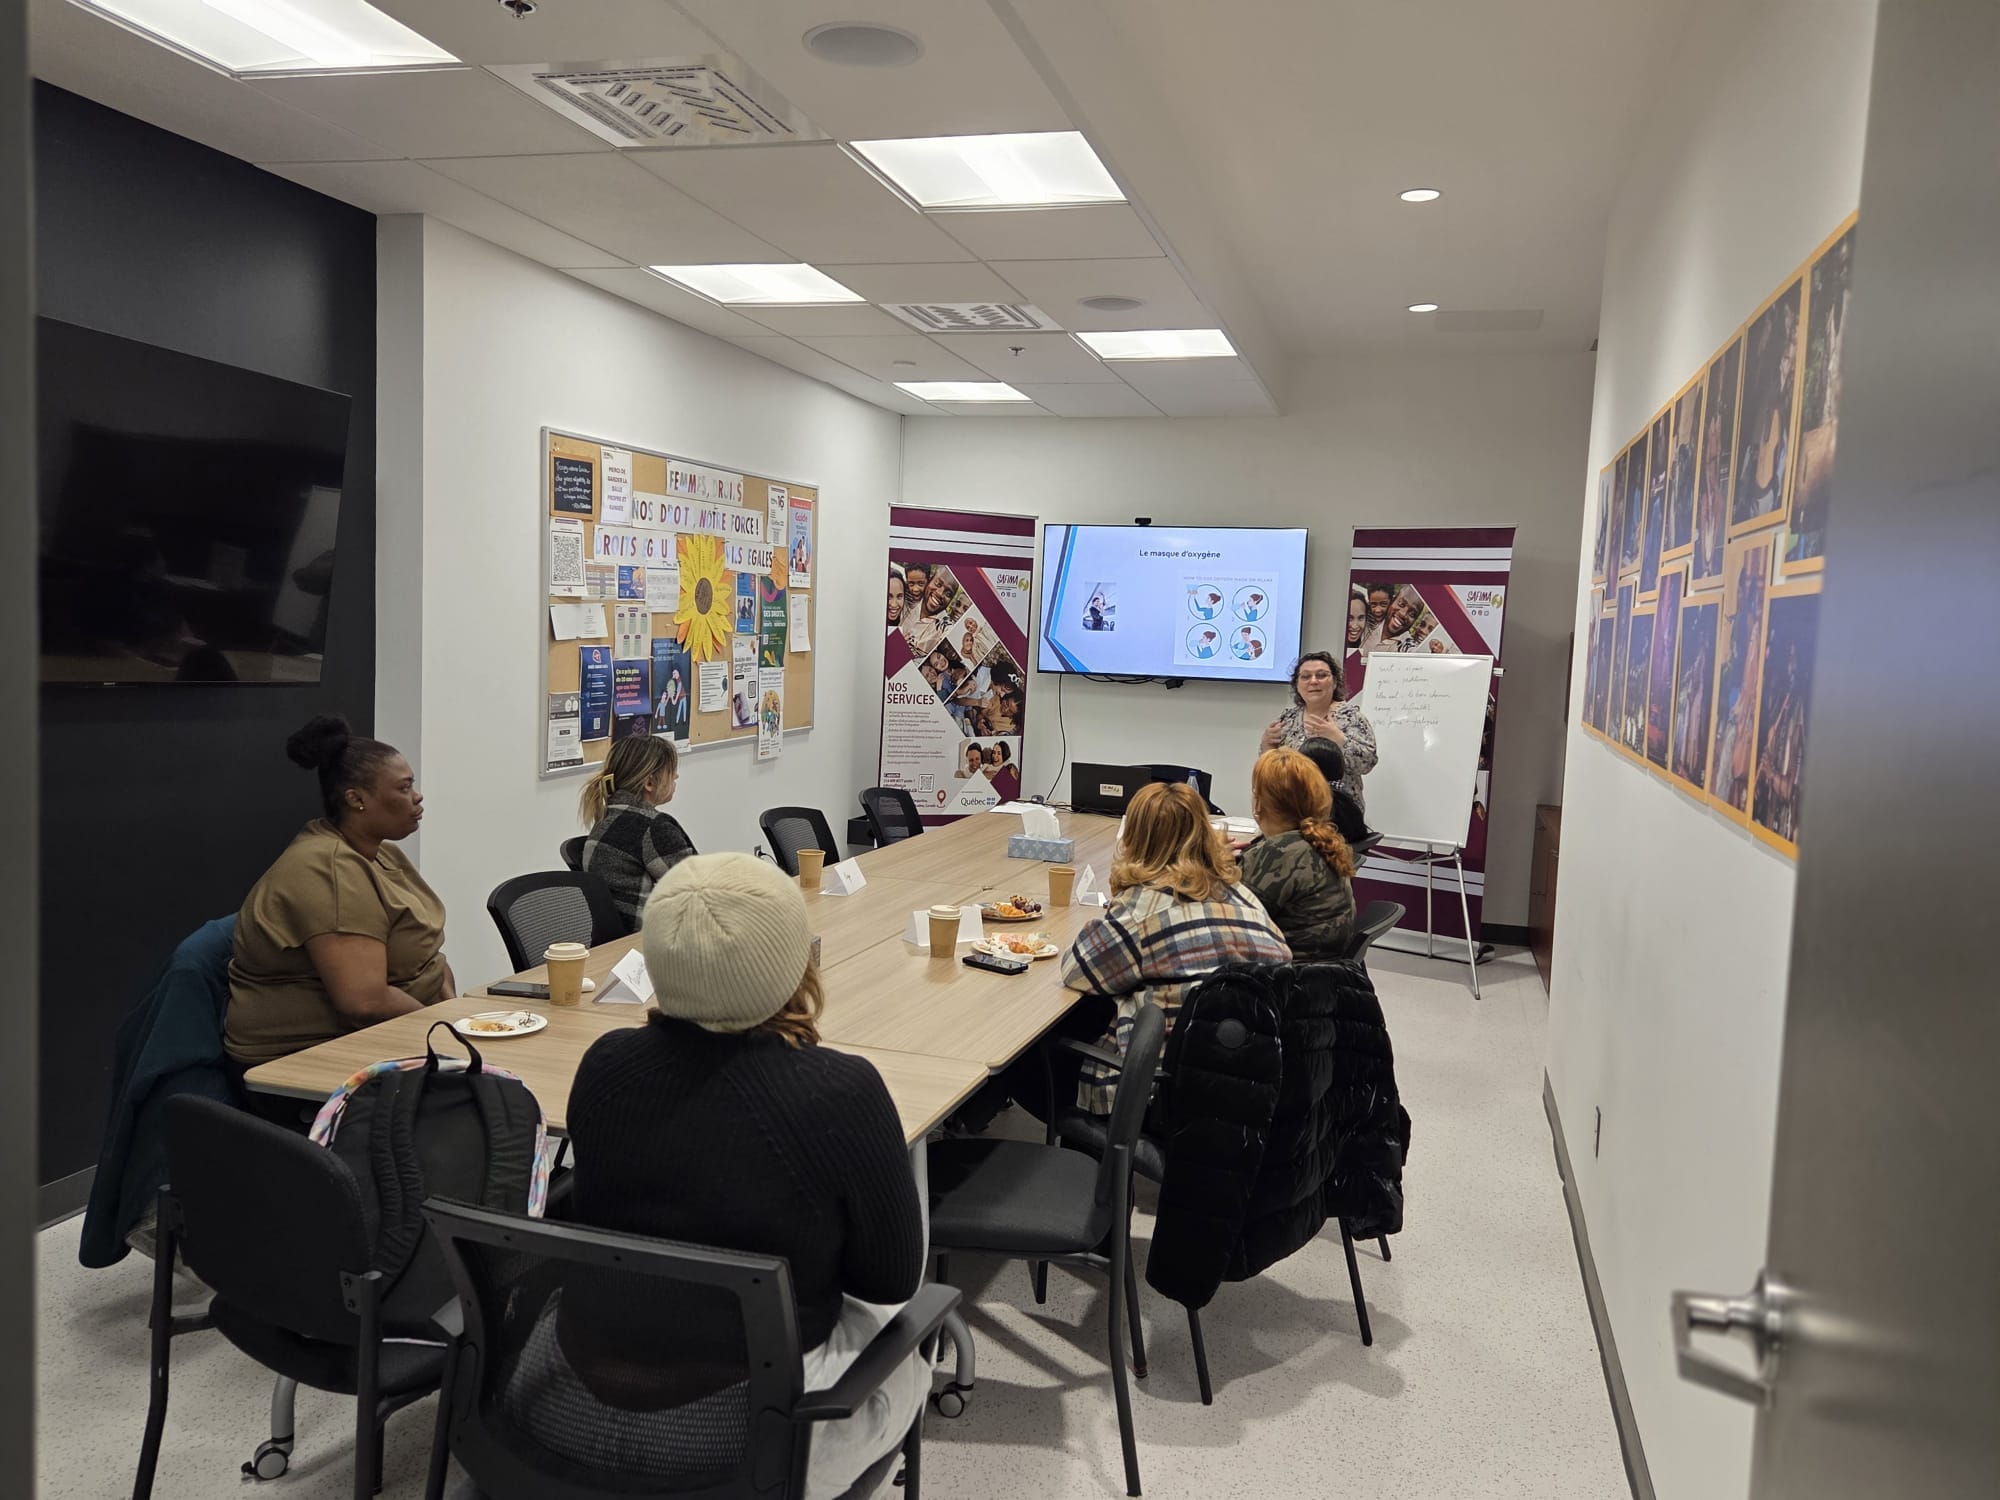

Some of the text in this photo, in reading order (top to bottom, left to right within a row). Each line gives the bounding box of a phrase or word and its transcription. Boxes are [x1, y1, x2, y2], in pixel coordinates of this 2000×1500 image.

[608, 475, 622, 483] GARDER
[777, 495, 785, 508] 16
[632, 498, 654, 522] NOS
[699, 508, 727, 531] NOTRE
[596, 534, 637, 557] DROITS
[747, 548, 773, 569] EGALES
[1150, 551, 1179, 559] masque
[1181, 550, 1220, 559] d'oxygène
[996, 574, 1019, 585] SAFIMA
[1466, 590, 1492, 602] SAFIMA
[888, 682, 908, 692] NOS
[887, 694, 935, 705] SERVICES
[960, 796, 986, 807] Québec
